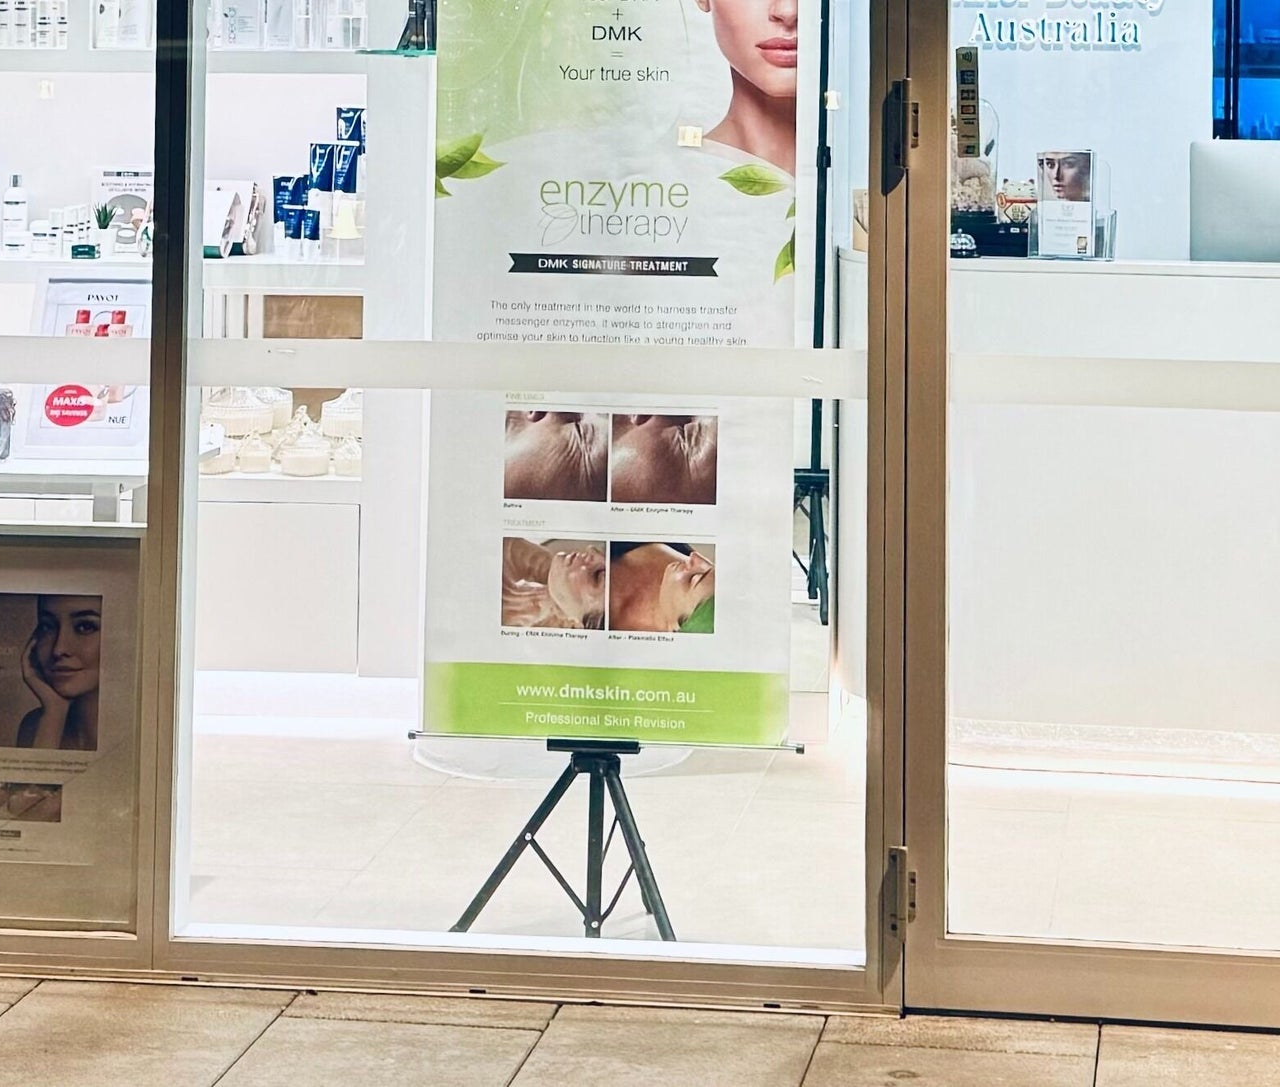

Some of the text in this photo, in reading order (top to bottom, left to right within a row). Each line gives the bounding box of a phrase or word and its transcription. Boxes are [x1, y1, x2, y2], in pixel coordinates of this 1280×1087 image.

[592, 26, 642, 41] DMK
[969, 11, 1140, 44] Australia
[559, 65, 595, 80] Your
[600, 67, 631, 81] true
[540, 180, 689, 212] enzyme
[579, 209, 689, 244] therapy
[538, 258, 689, 272] DMK SIGNATURE TREATMENT
[87, 294, 120, 302] PAYOT
[491, 300, 737, 315] The only treatment in the world to harness transfer
[495, 317, 550, 328] messenger
[611, 319, 640, 329] works
[643, 320, 653, 329] to
[656, 321, 710, 332] strengthen
[713, 322, 732, 330] and
[477, 332, 519, 342] optimise
[522, 333, 543, 343] your
[546, 333, 567, 342] skin
[569, 334, 579, 342] to
[581, 334, 621, 344] function
[624, 334, 640, 343] like
[687, 336, 723, 345] healthy
[516, 684, 696, 703] www.dmkskin.com.au
[526, 712, 686, 729] Professional Skin Revision
